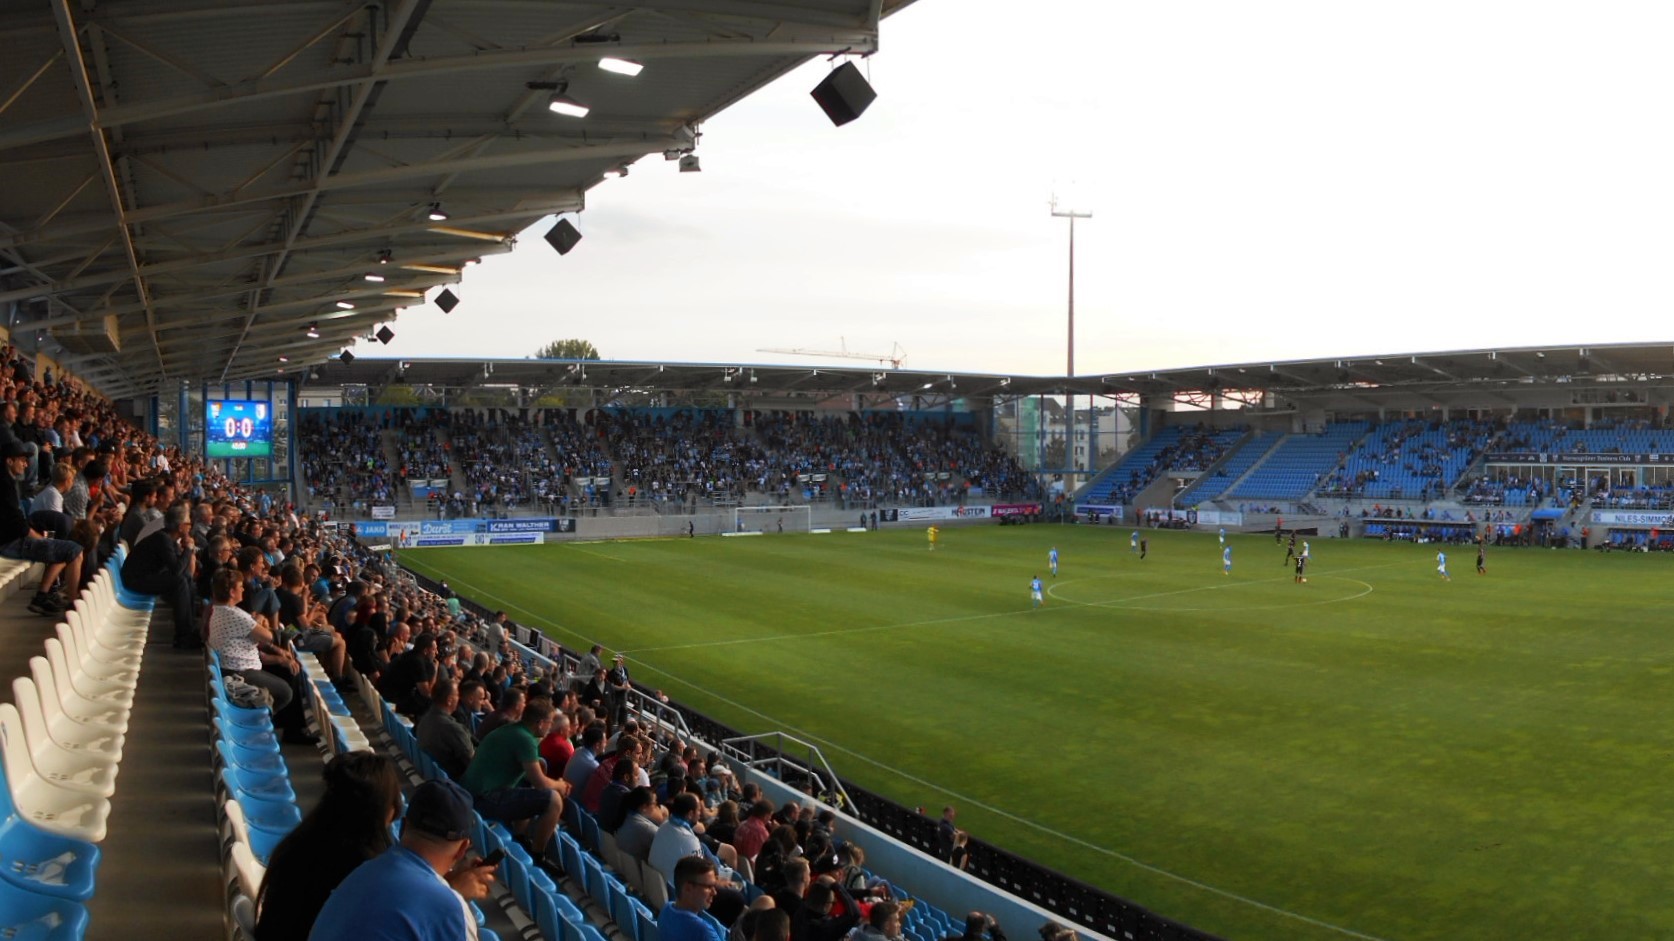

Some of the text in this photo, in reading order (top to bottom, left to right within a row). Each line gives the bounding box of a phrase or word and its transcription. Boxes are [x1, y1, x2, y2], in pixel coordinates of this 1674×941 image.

[226, 417, 252, 437] 0:0
[365, 526, 385, 534] JAKO
[490, 521, 550, 532] KRAN WALTHER
